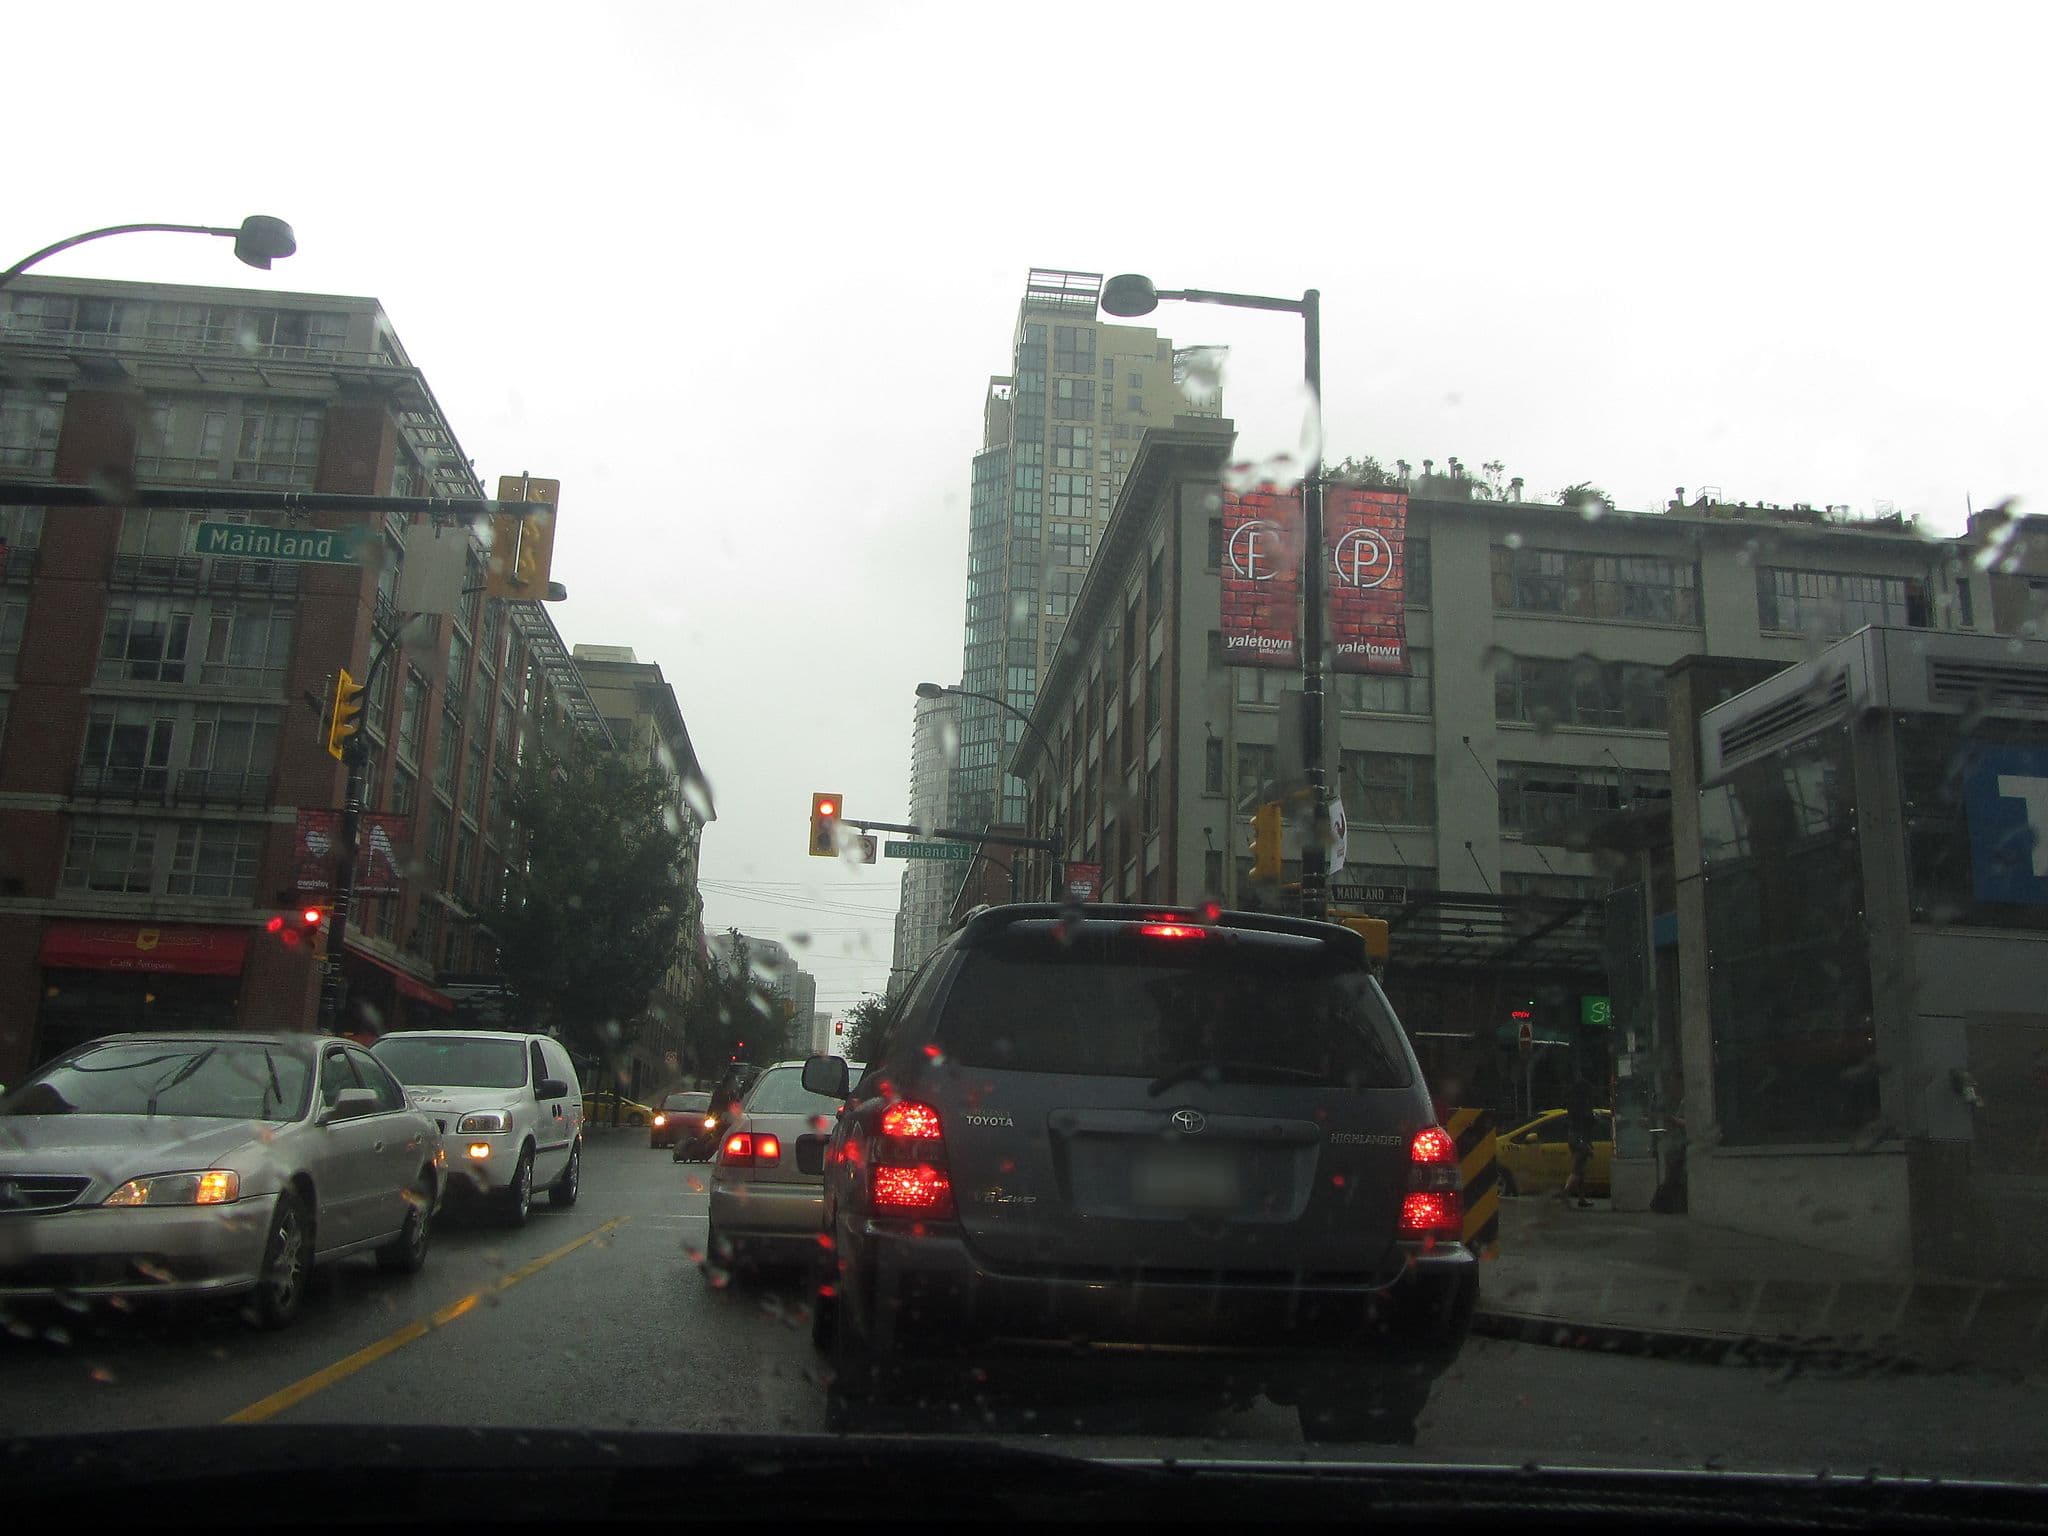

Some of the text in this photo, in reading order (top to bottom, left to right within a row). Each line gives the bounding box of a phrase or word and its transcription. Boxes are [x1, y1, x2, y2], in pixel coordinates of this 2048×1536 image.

[209, 528, 332, 558] Mainland
[1353, 539, 1379, 587] P
[1227, 634, 1292, 650] yaletown
[1336, 643, 1399, 656] yaletown
[891, 845, 964, 859] Mainland St
[1337, 887, 1385, 900] MAINLAND
[966, 1115, 1014, 1127] TOYOTA
[1330, 1133, 1402, 1146] HIGHLANDER
